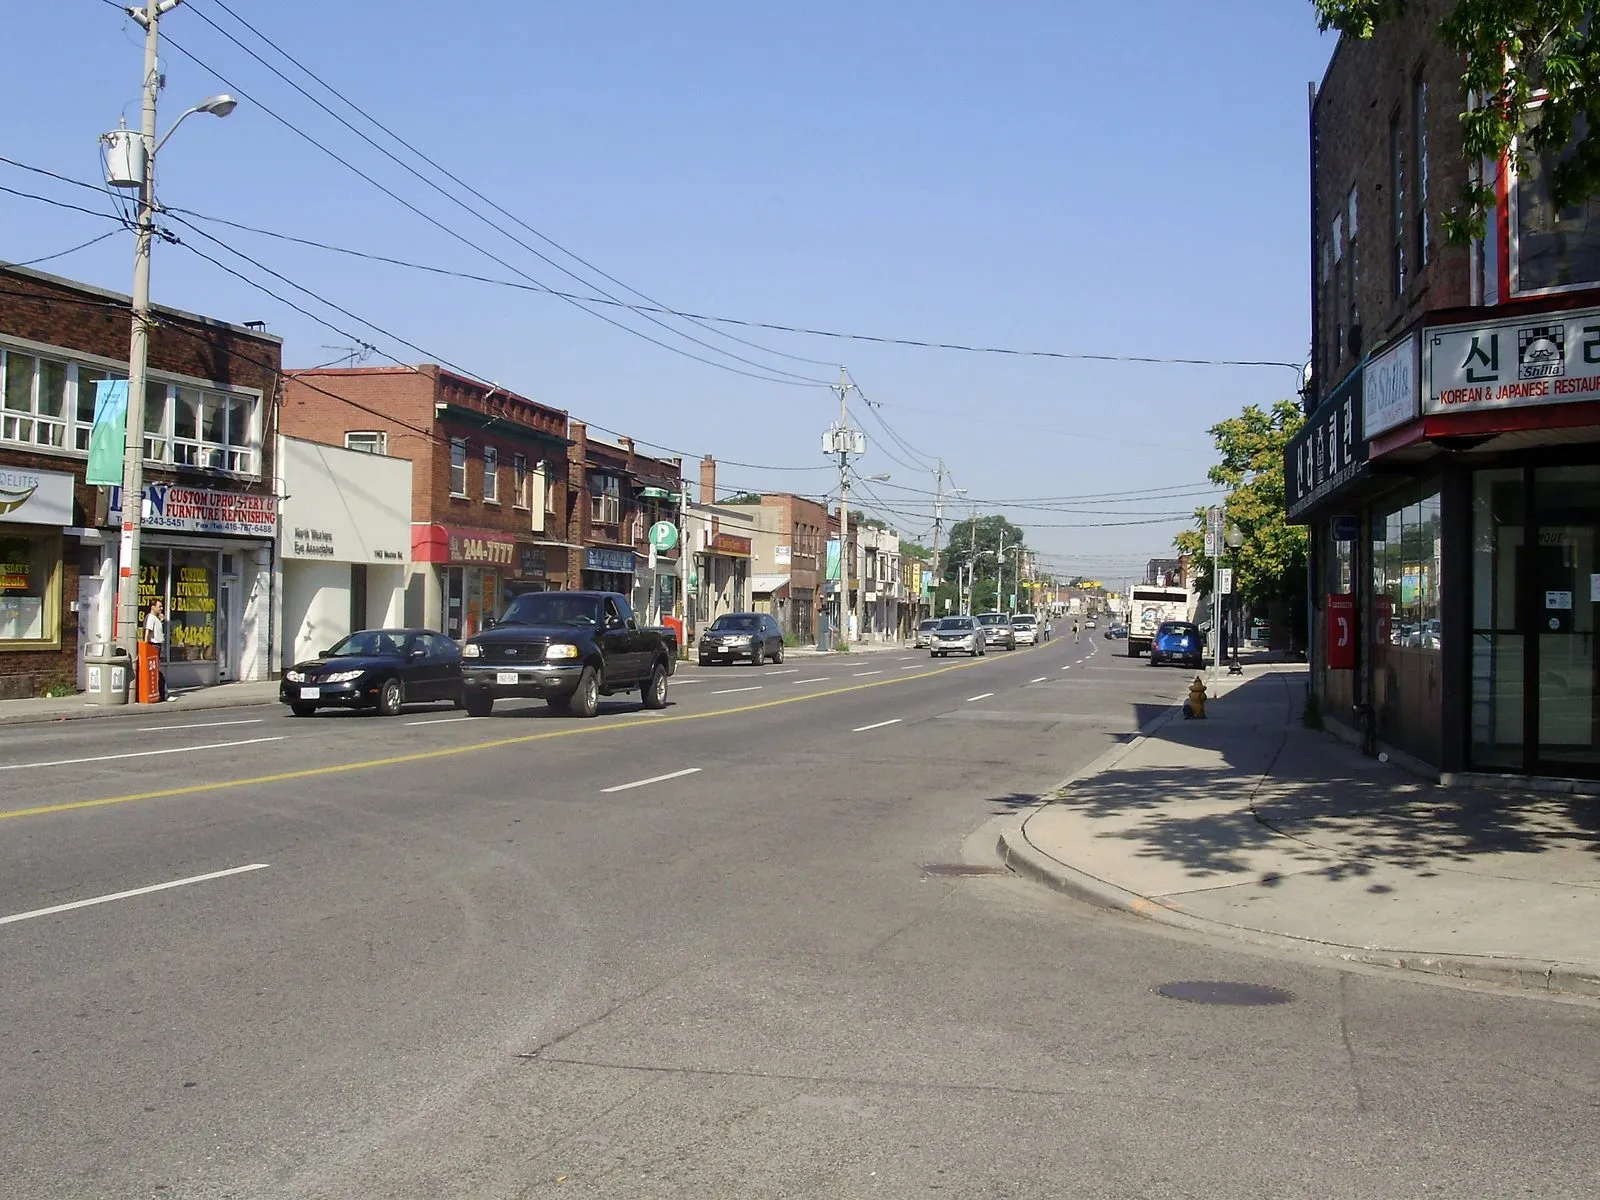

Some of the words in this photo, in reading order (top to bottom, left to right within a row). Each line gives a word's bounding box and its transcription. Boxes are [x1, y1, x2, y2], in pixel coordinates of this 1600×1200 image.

[1523, 364, 1560, 378] Shilla
[1440, 387, 1482, 405] KOREAN
[1485, 386, 1492, 400] &
[1495, 380, 1549, 400] JAPANESE
[169, 490, 207, 507] CUSTOM
[210, 493, 265, 510] UPHOLTERY
[166, 503, 219, 521] FURNITURE
[221, 508, 275, 524] REFINISHING
[657, 524, 670, 543] P
[463, 538, 514, 564] 244-7777
[137, 584, 156, 595] STOM
